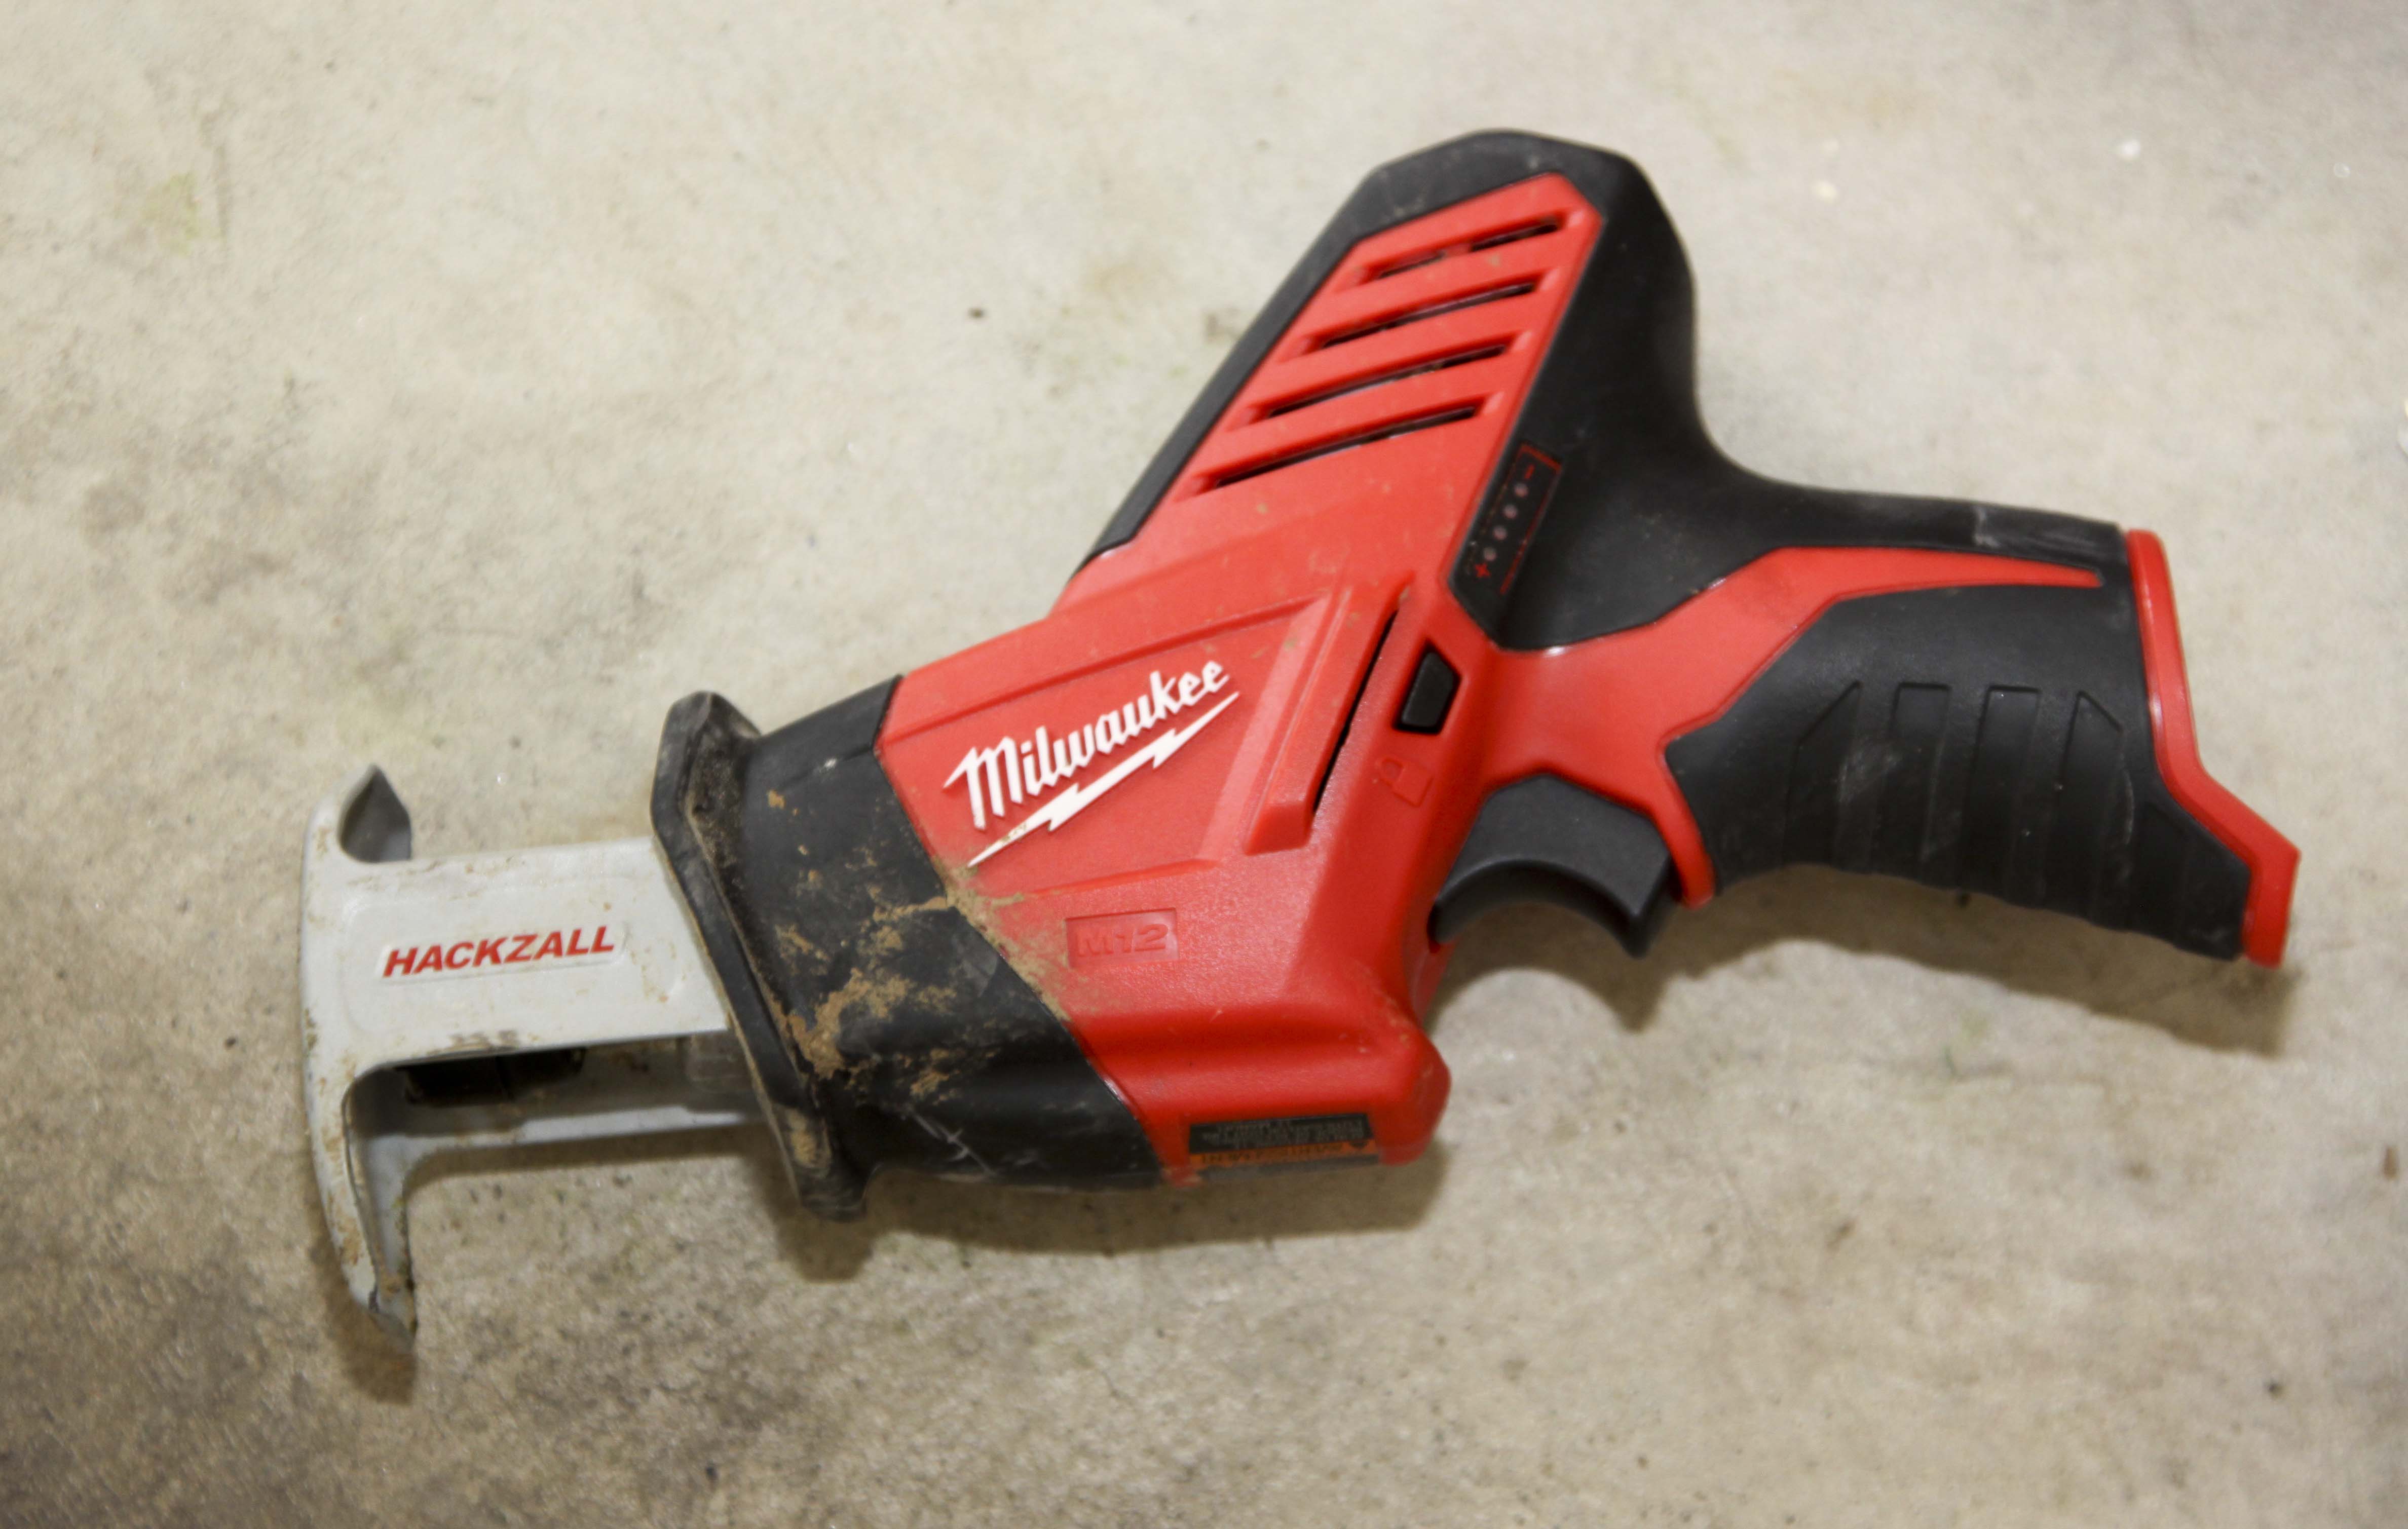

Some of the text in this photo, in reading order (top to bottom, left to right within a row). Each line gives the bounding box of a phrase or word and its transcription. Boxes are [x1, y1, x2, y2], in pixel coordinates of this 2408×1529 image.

[943, 660, 1230, 830] Milwaukee
[383, 926, 614, 978] HACKZALL
[1076, 924, 1169, 958] M12
